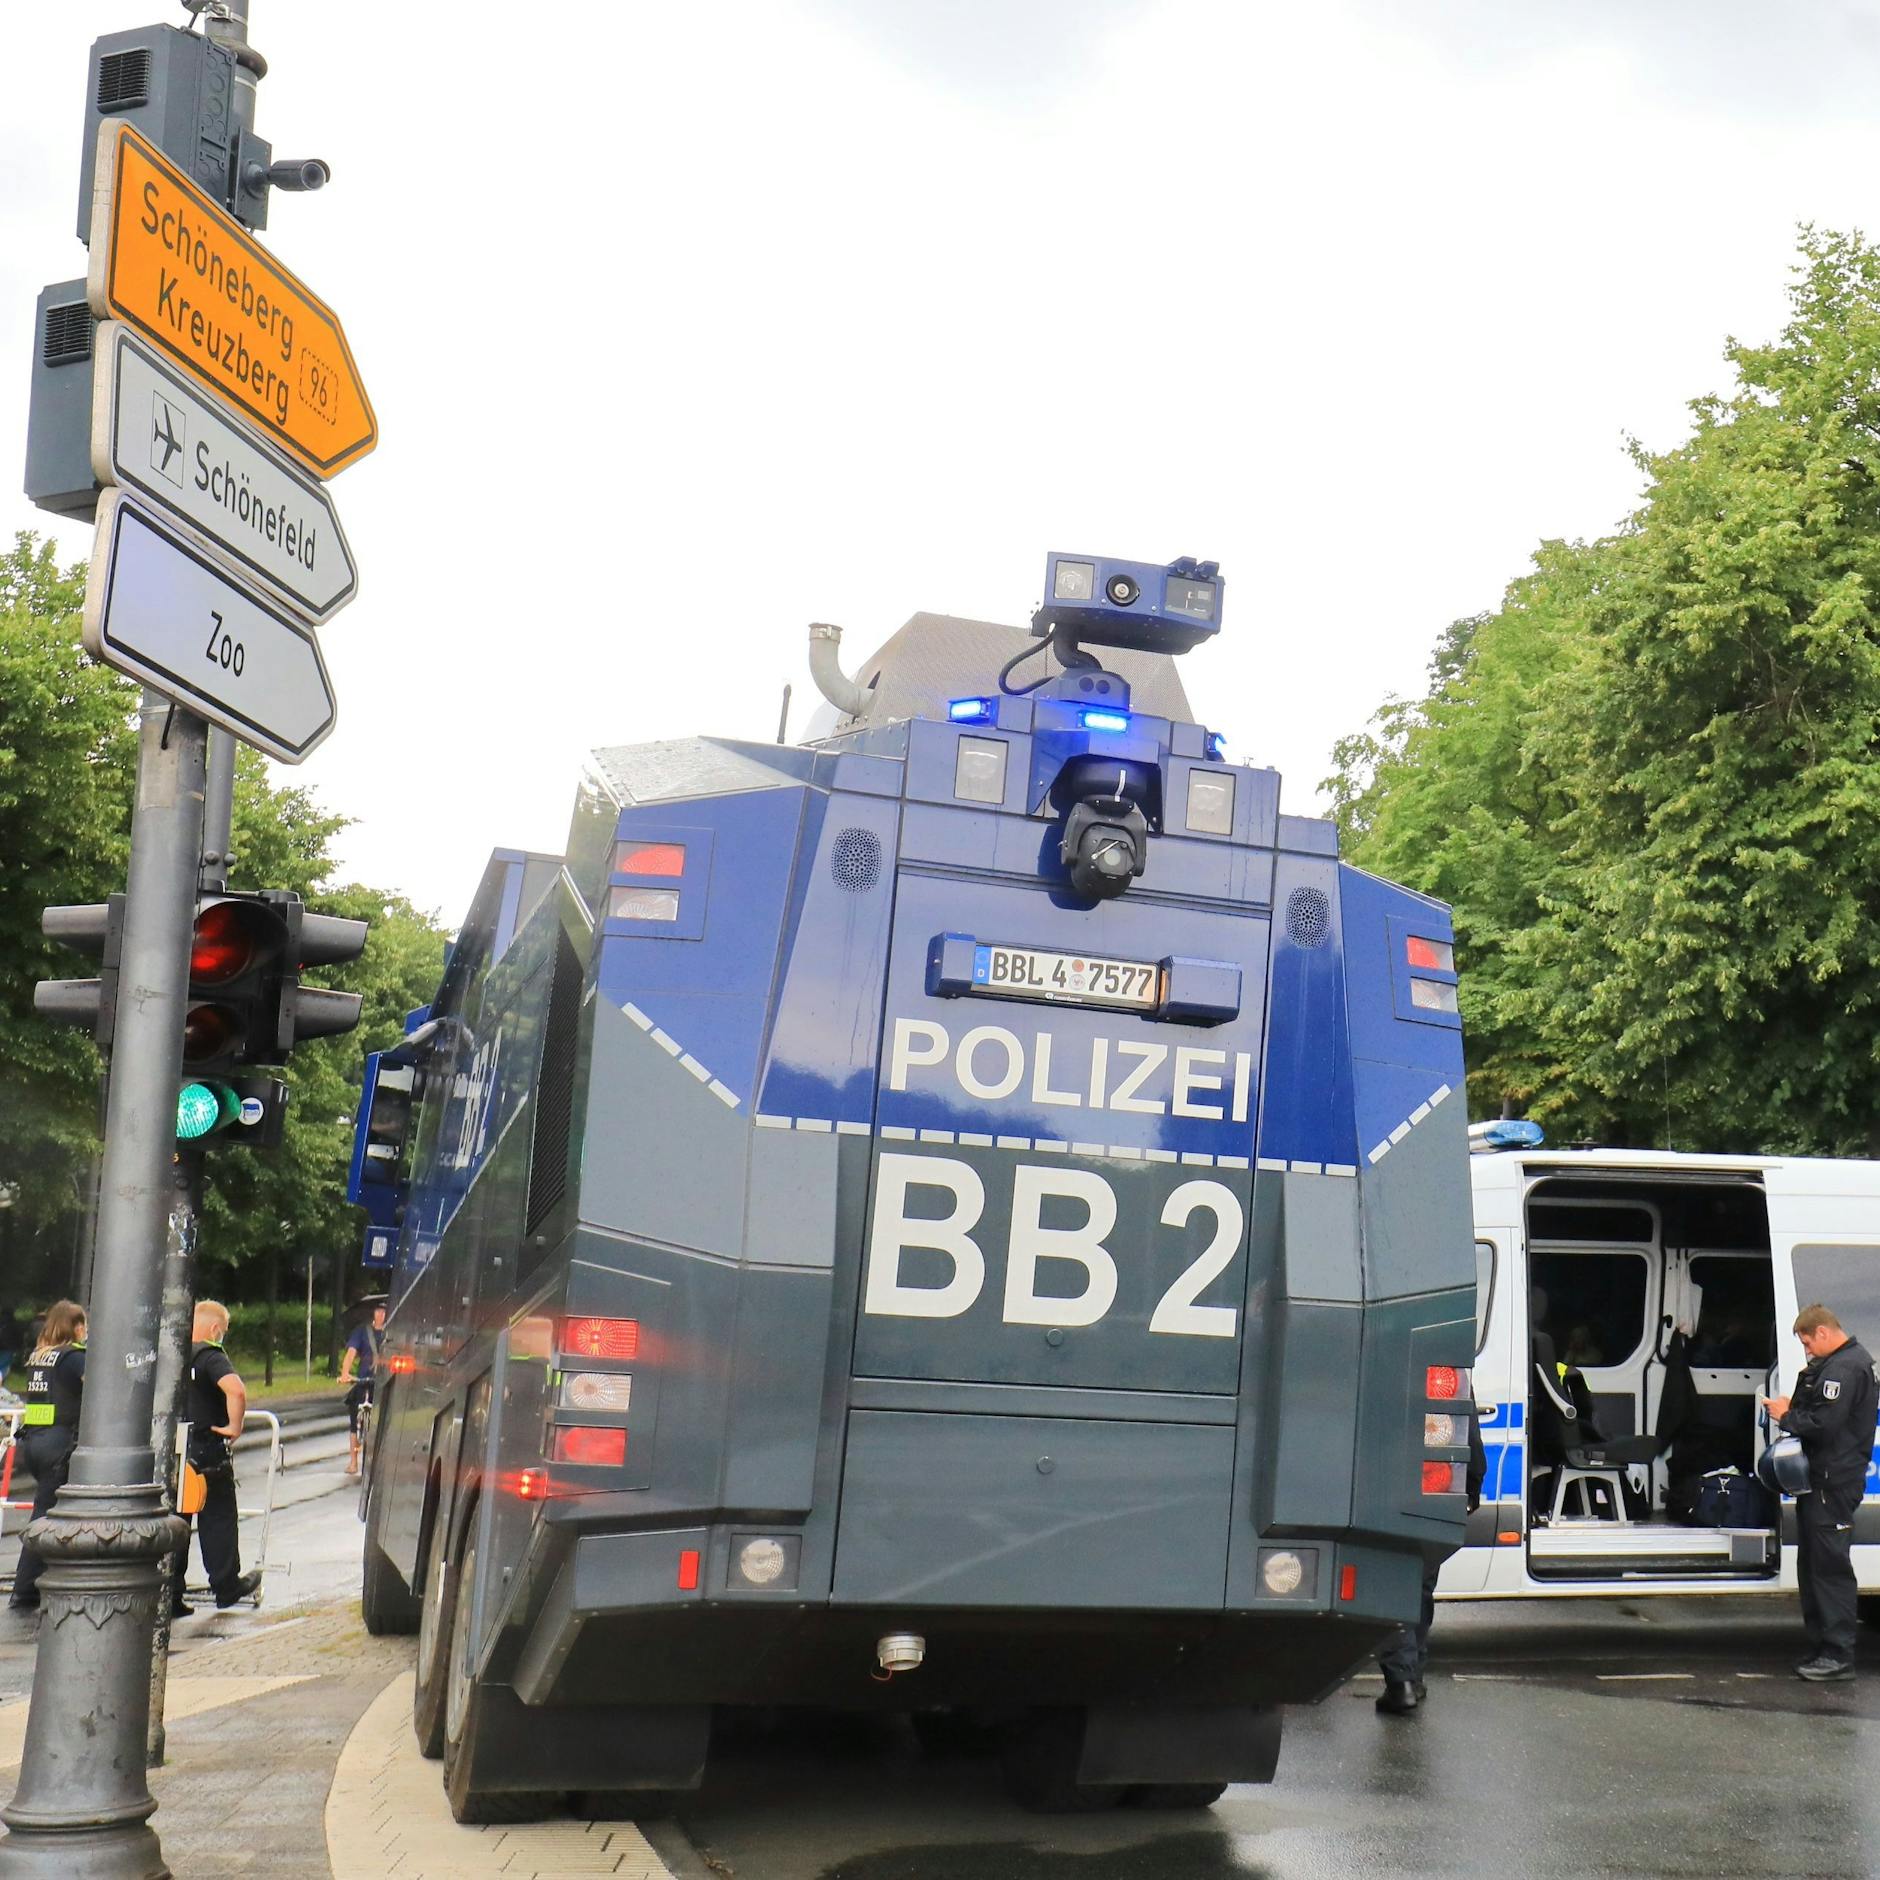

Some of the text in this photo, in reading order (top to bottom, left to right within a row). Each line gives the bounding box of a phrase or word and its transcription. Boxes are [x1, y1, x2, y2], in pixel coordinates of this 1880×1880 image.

[141, 181, 293, 362] Schöneberg
[158, 268, 289, 426] Kreuzberg
[310, 367, 328, 408] 96
[194, 440, 316, 572] Schönefeld
[206, 610, 245, 677] Zoo
[977, 952, 1153, 996] D BBL 4 7577
[890, 1017, 1251, 1123] POLIZEI
[1148, 1180, 1244, 1338] 2
[33, 1371, 44, 1381] BE
